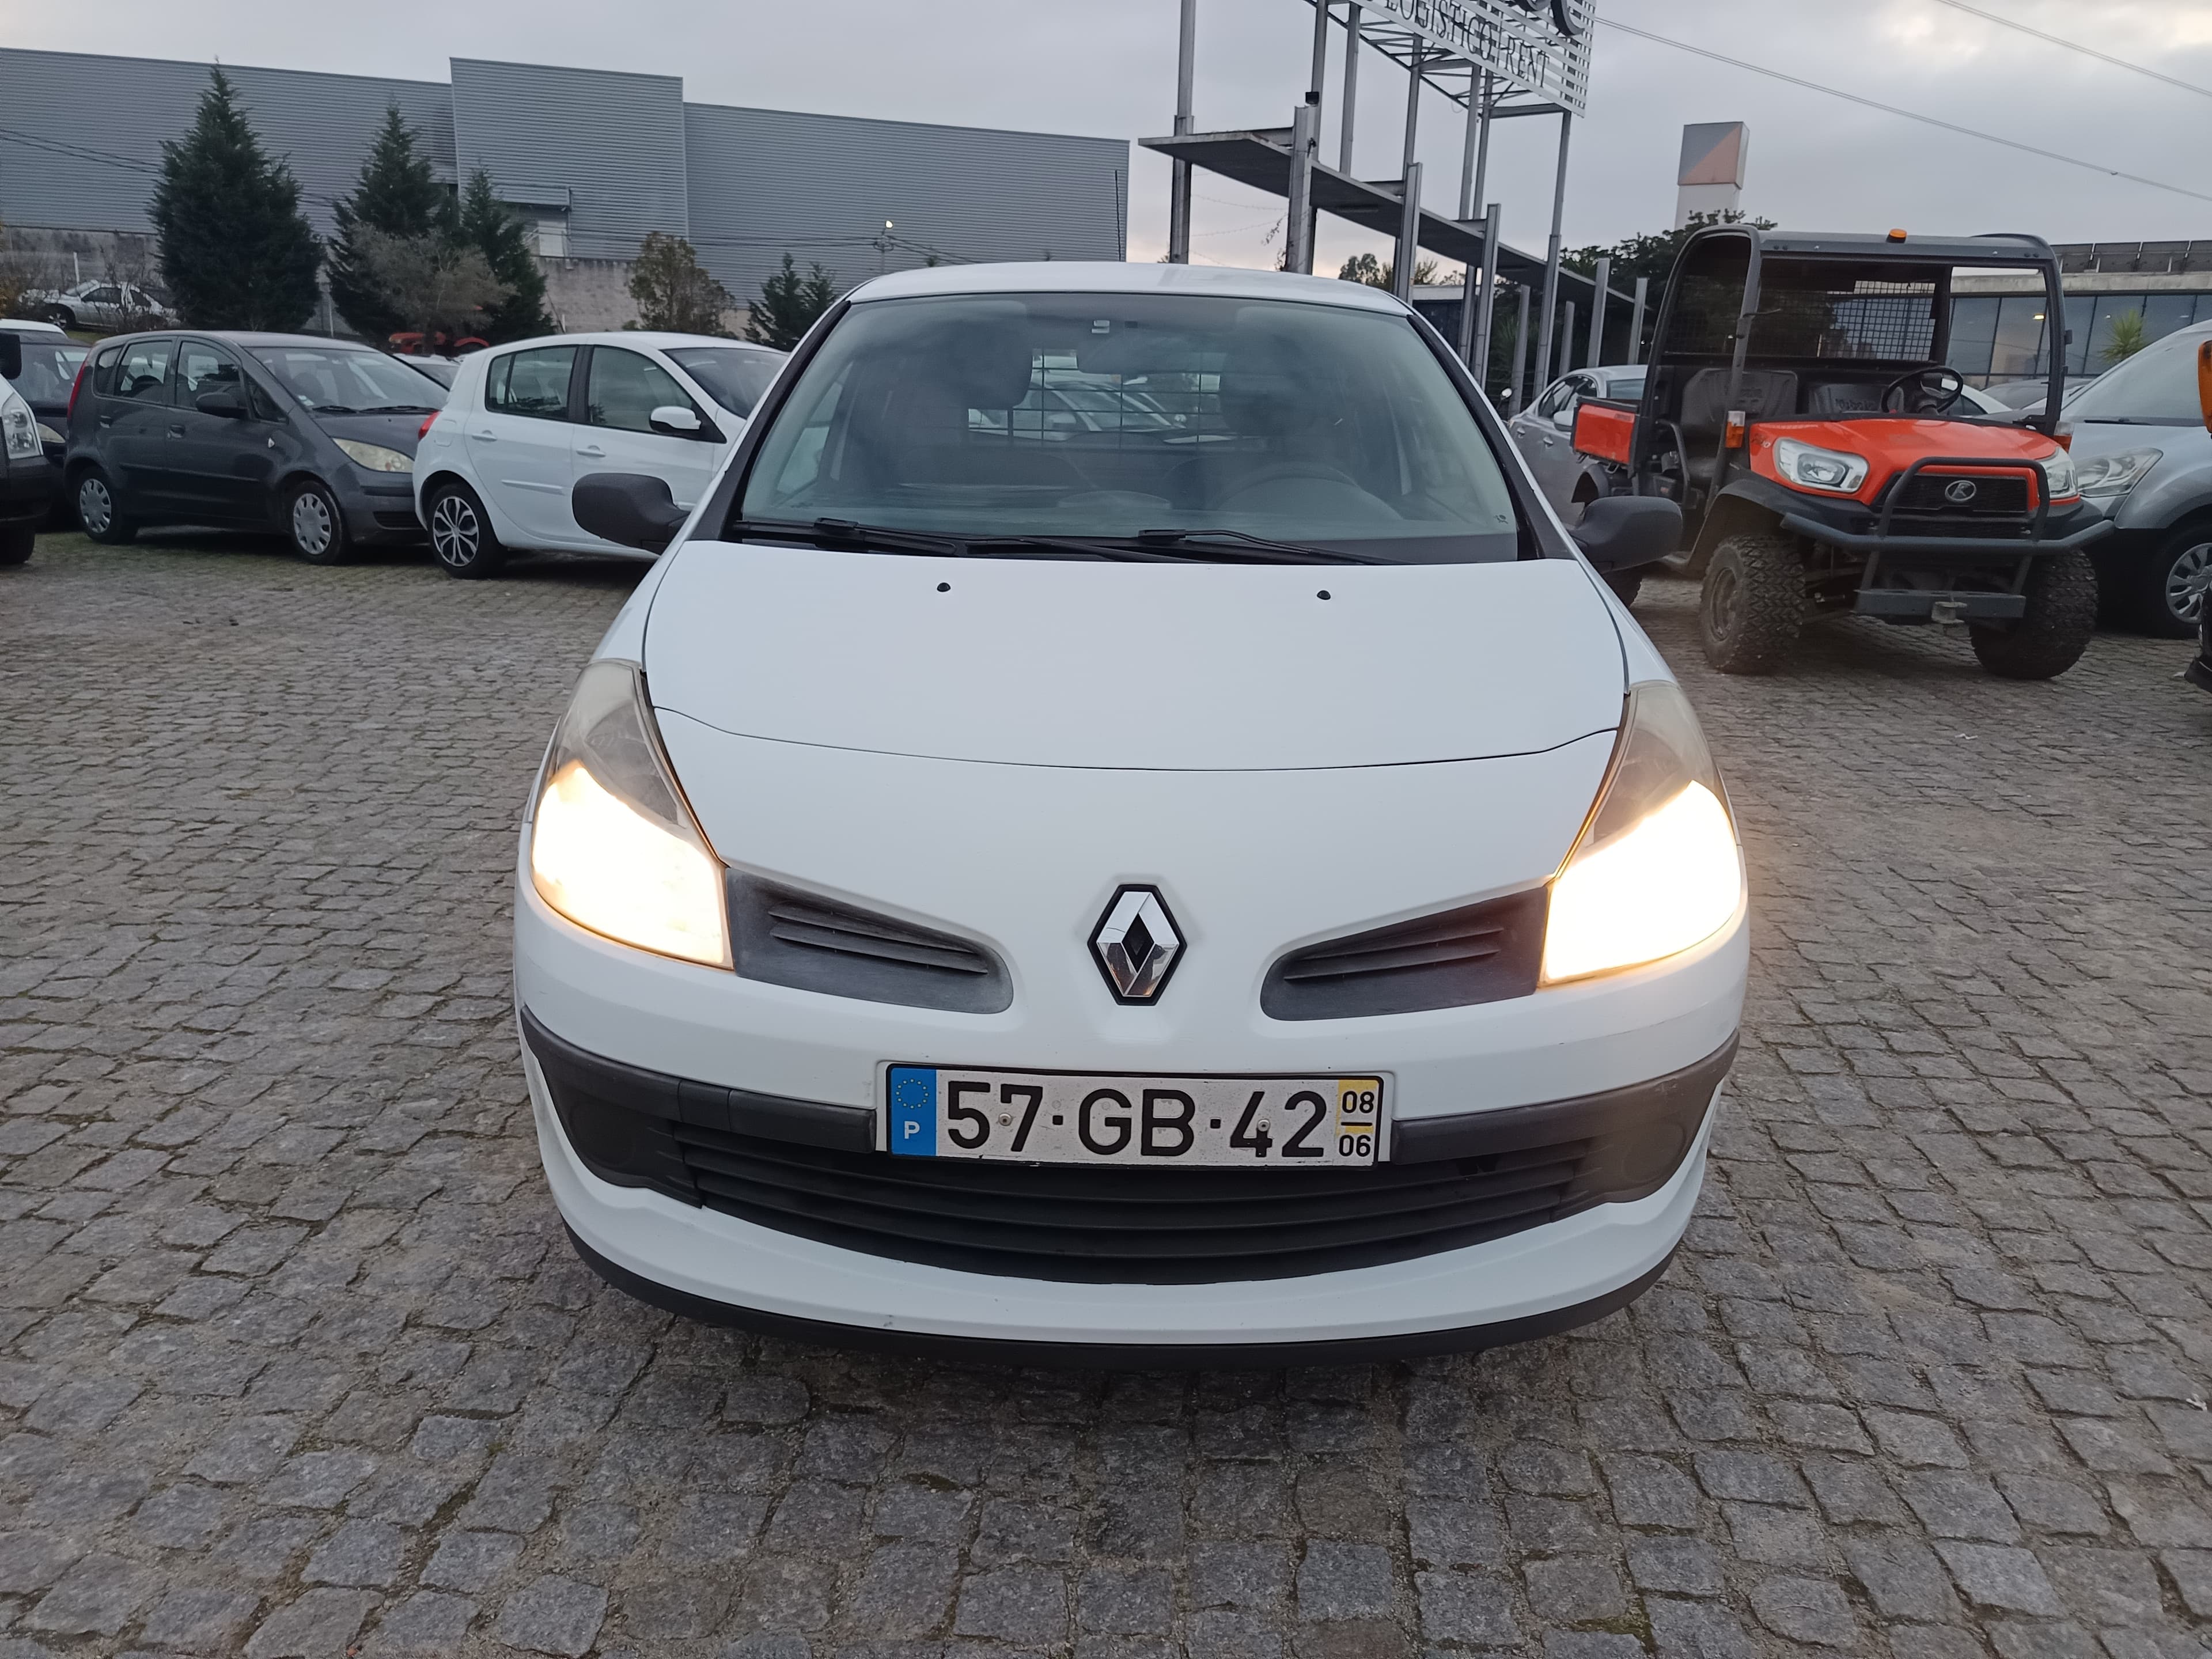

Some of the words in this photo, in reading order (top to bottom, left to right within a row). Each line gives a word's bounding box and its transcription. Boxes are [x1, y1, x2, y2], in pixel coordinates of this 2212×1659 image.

[1505, 35, 1550, 88] RENT
[1342, 1090, 1374, 1113] 08
[904, 1121, 920, 1139] P
[1339, 1134, 1371, 1157] 06
